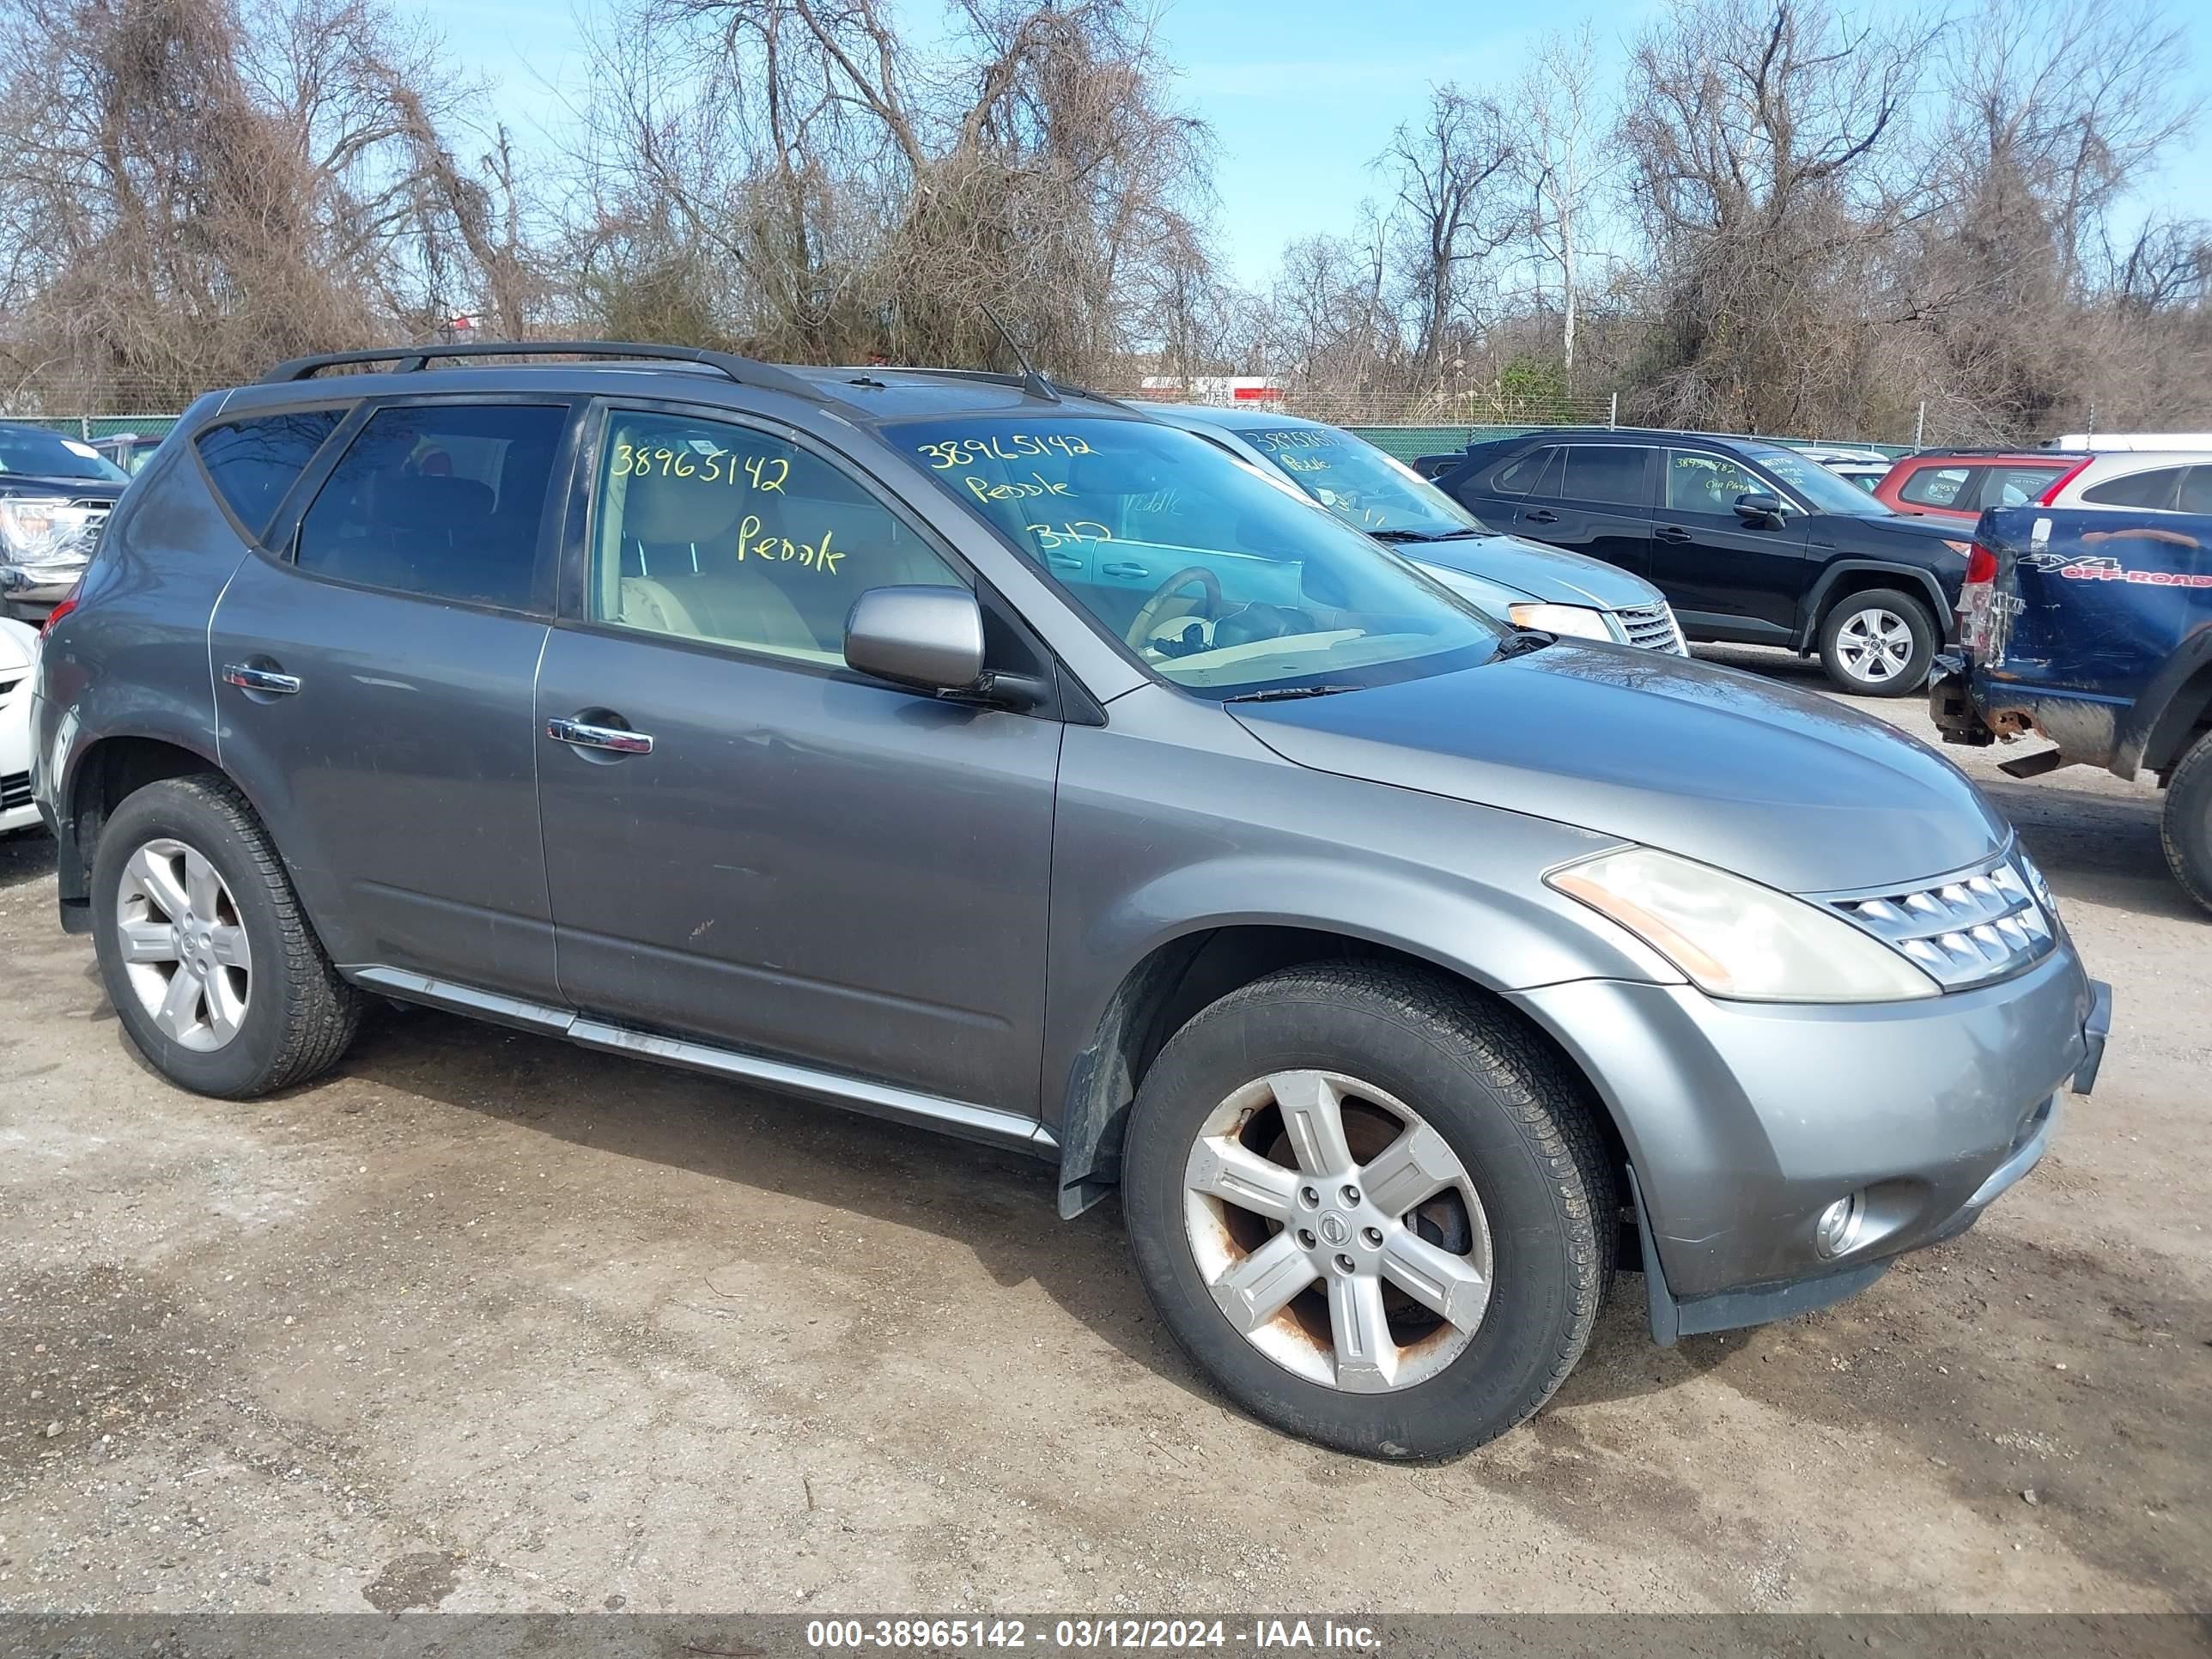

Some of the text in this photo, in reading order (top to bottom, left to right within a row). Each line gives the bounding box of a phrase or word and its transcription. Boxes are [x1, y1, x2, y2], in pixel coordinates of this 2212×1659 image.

[918, 434, 1104, 469] 38965142
[611, 445, 789, 495] 38965142
[2061, 567, 2212, 590] OFF-ROAD
